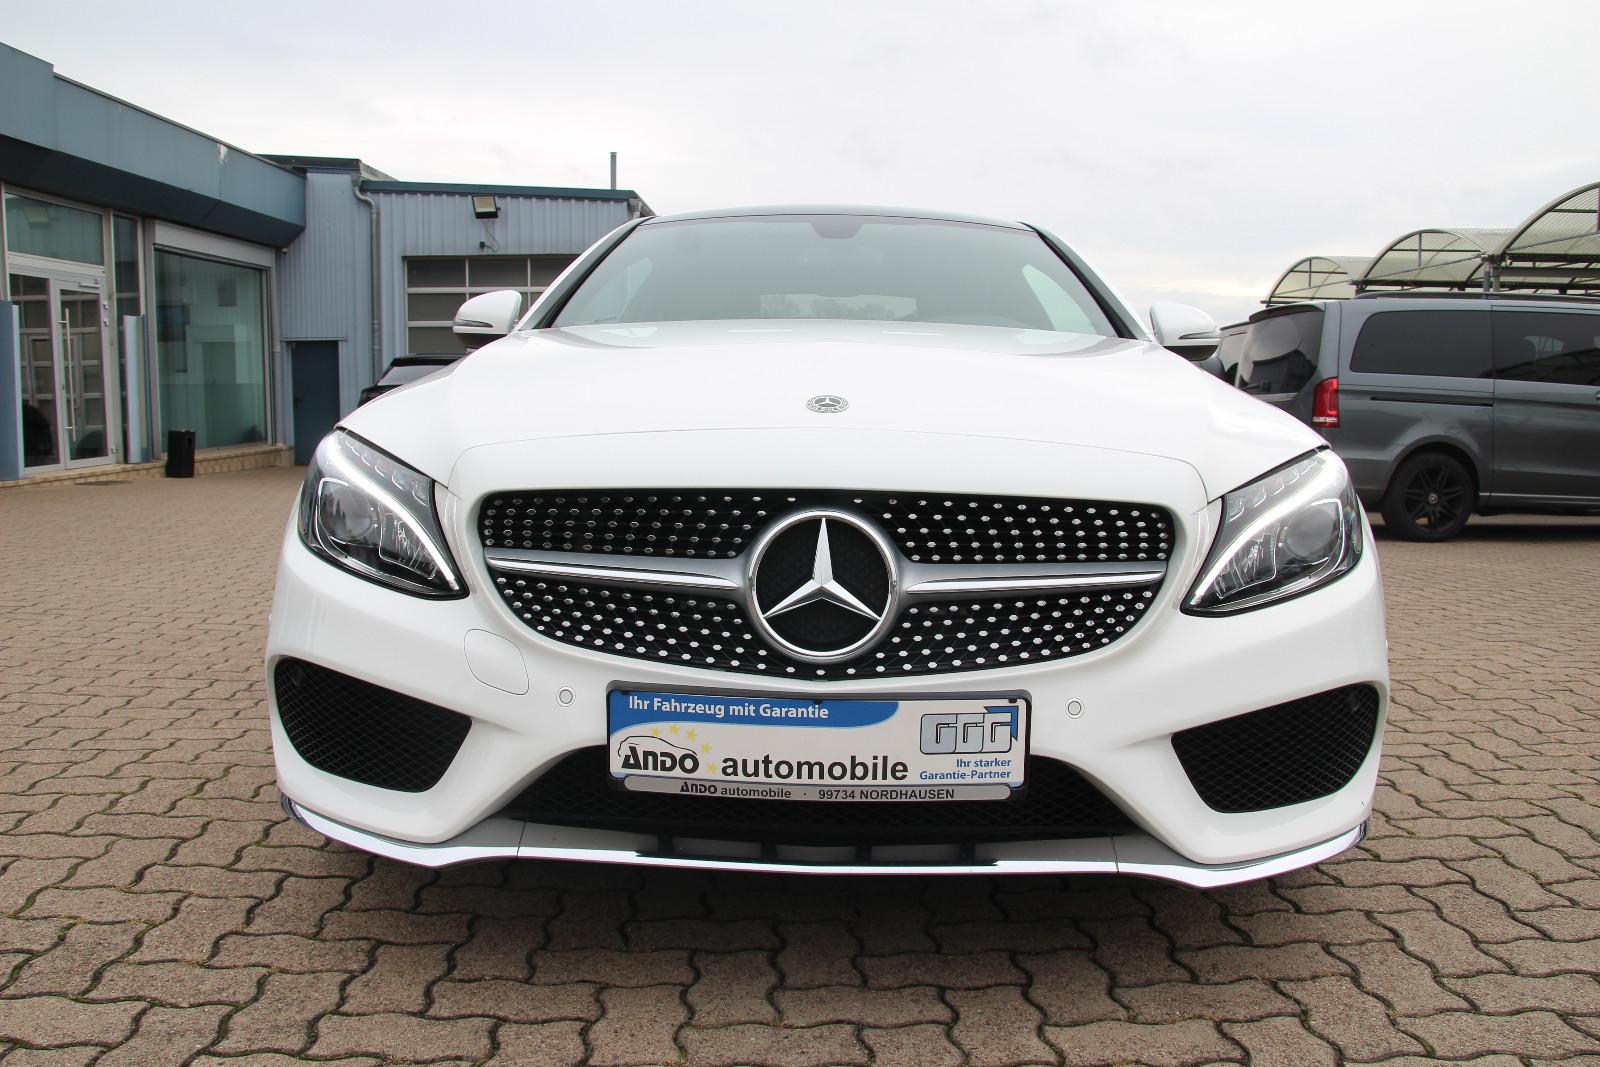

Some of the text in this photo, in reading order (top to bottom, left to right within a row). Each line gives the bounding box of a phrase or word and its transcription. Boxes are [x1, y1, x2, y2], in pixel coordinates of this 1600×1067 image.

[629, 696, 829, 719] Ihr Fahrzeug mit Garantie
[721, 754, 909, 781] automobile
[956, 757, 1012, 768] Ihr starker
[919, 769, 1012, 780] Garantie-Partner
[720, 785, 792, 798] automobile
[818, 789, 856, 800] 99734
[859, 788, 955, 800] NORDHAUSEN
